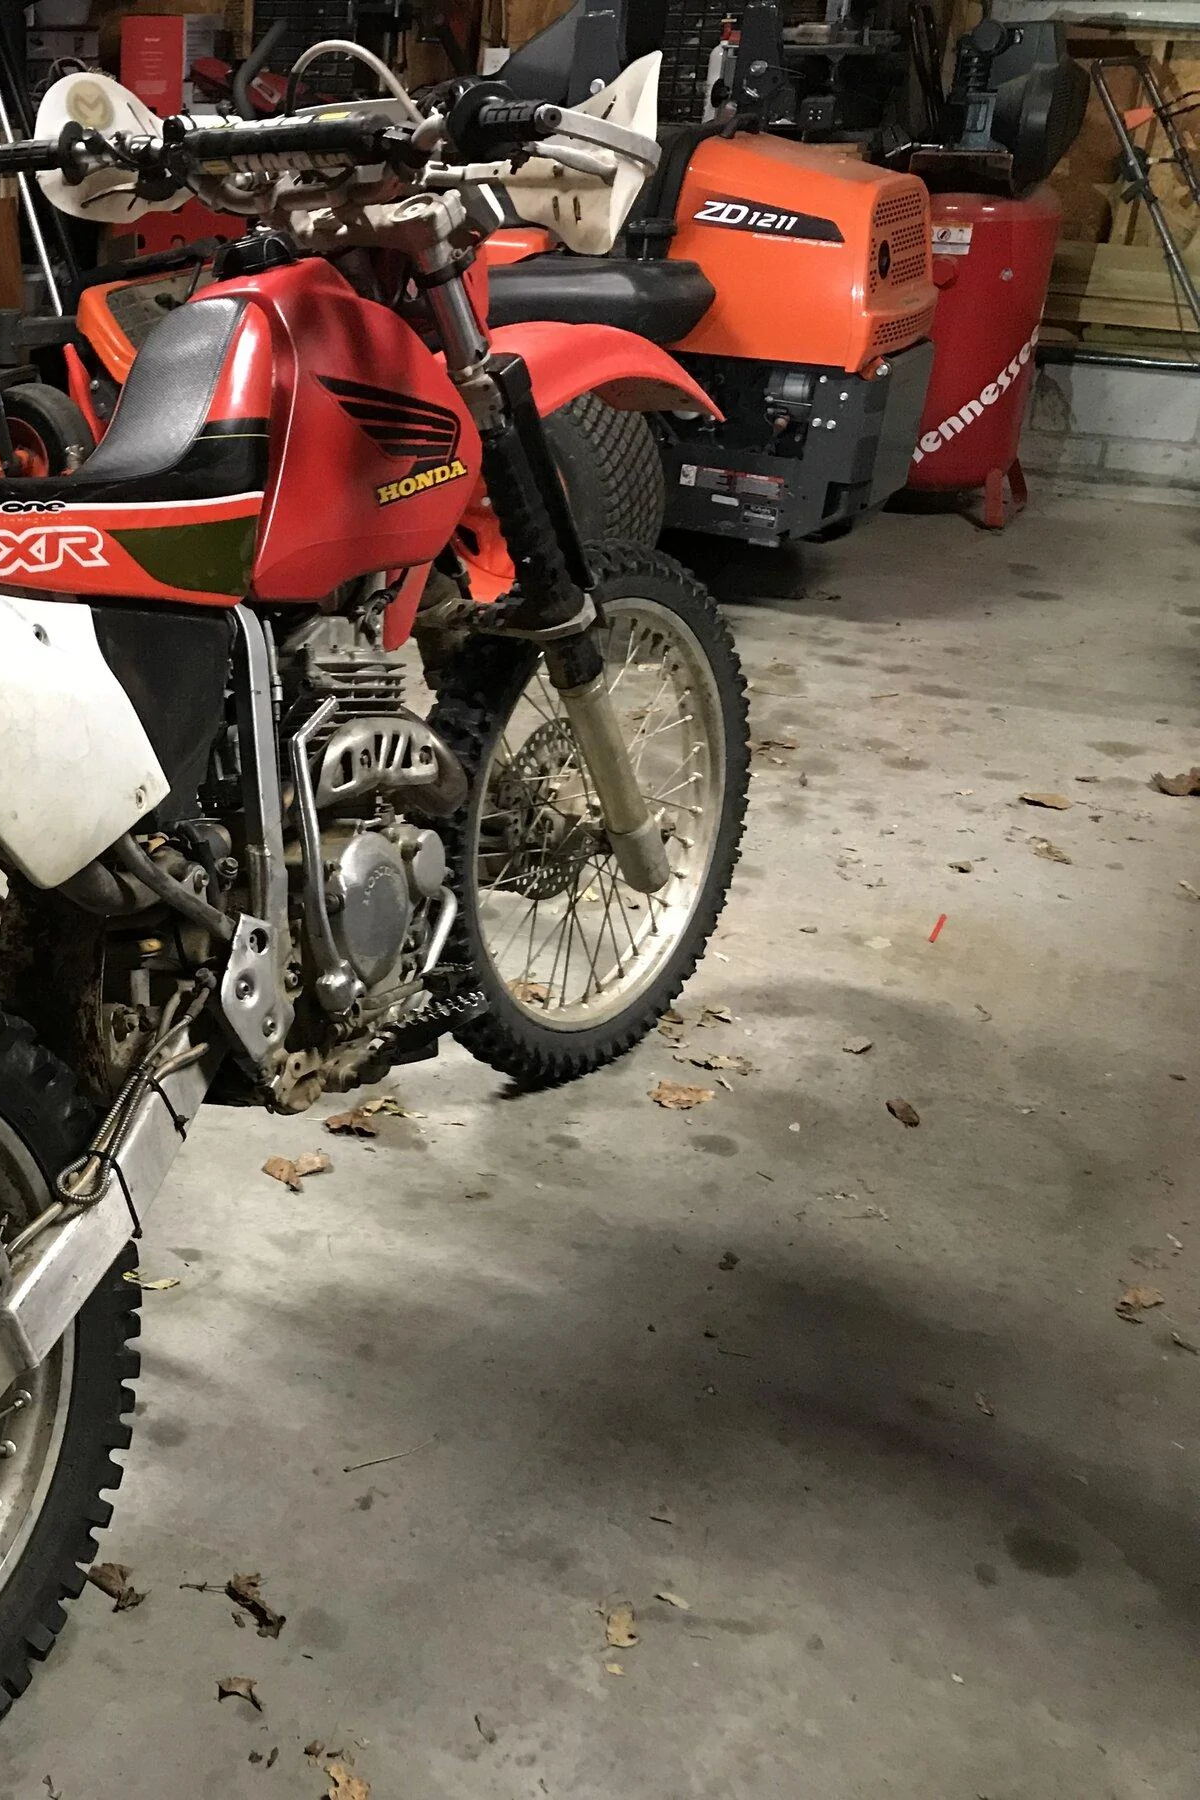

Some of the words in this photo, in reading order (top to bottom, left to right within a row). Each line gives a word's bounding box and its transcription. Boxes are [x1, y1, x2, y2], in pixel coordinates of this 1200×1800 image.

[693, 200, 750, 224] ZD
[747, 211, 798, 231] 1211
[377, 460, 467, 504] HONDA
